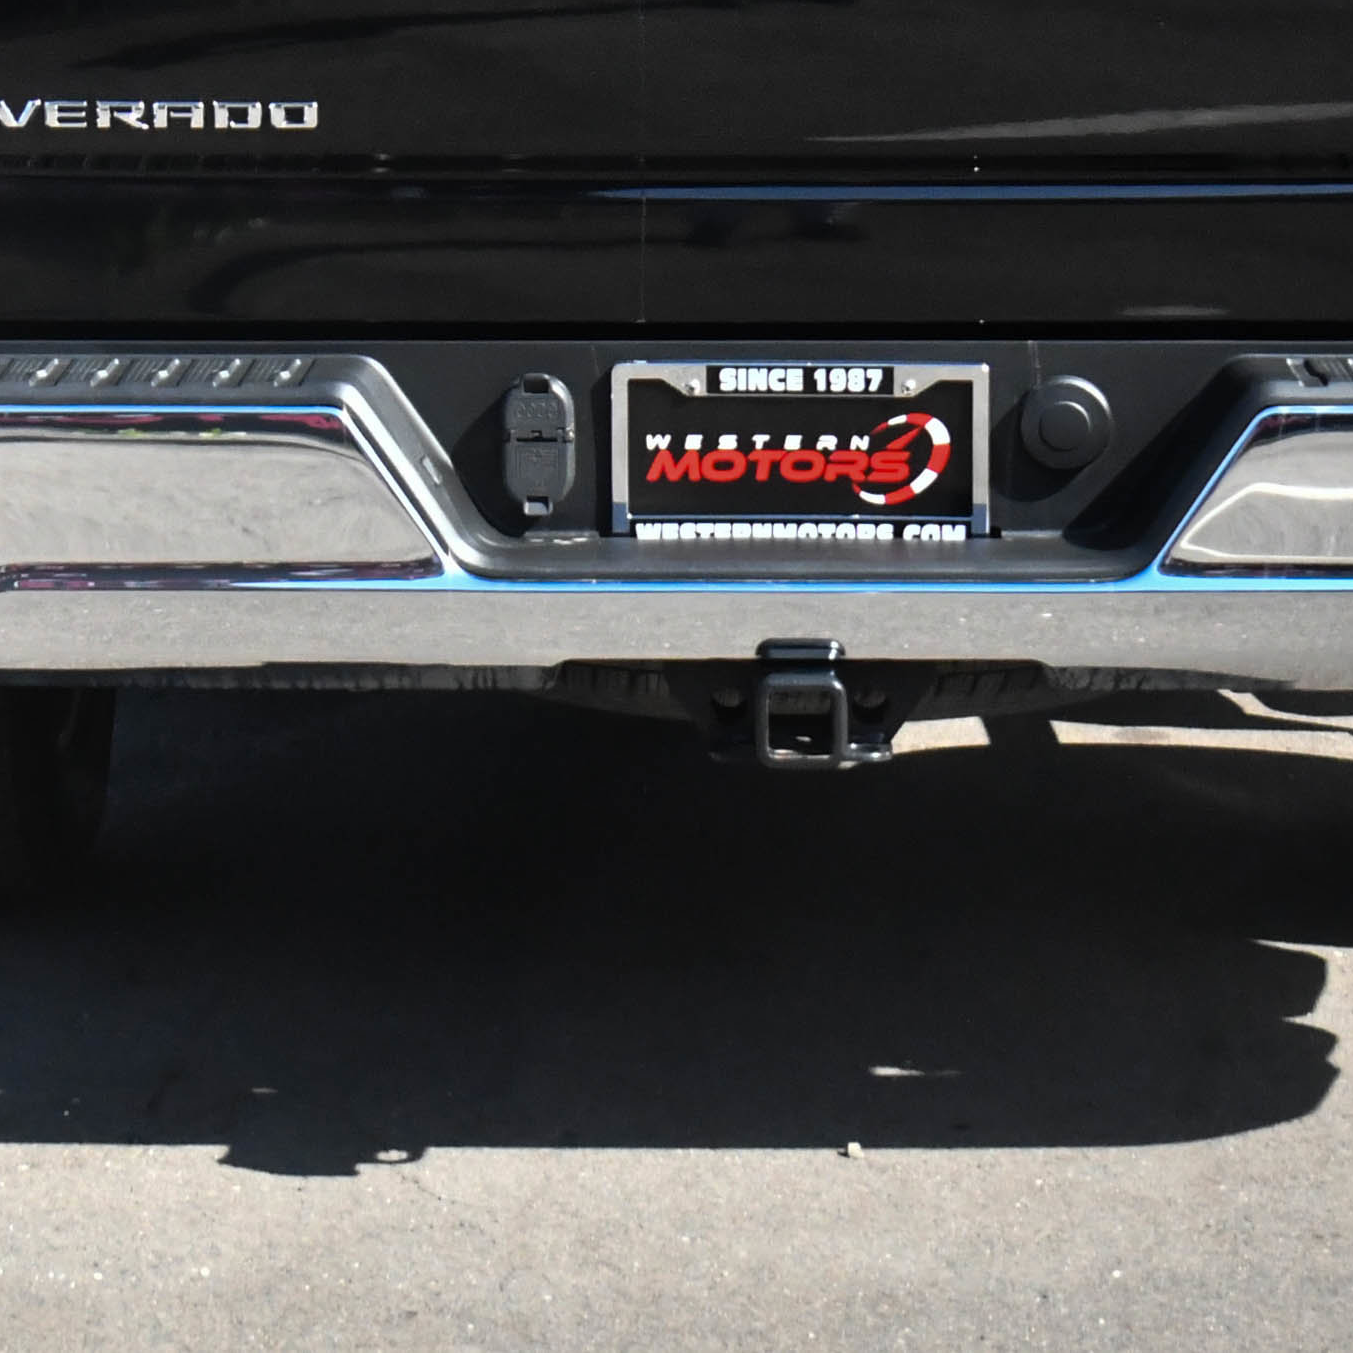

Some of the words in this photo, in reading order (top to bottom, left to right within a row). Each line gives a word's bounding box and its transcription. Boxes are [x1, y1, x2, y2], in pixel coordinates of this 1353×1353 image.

[718, 367, 804, 393] SINCE
[813, 367, 885, 393] 1987
[645, 433, 870, 451] WESTERN
[646, 450, 910, 482] MOTORS
[635, 522, 968, 543] WESTERNMOTORSCOM
